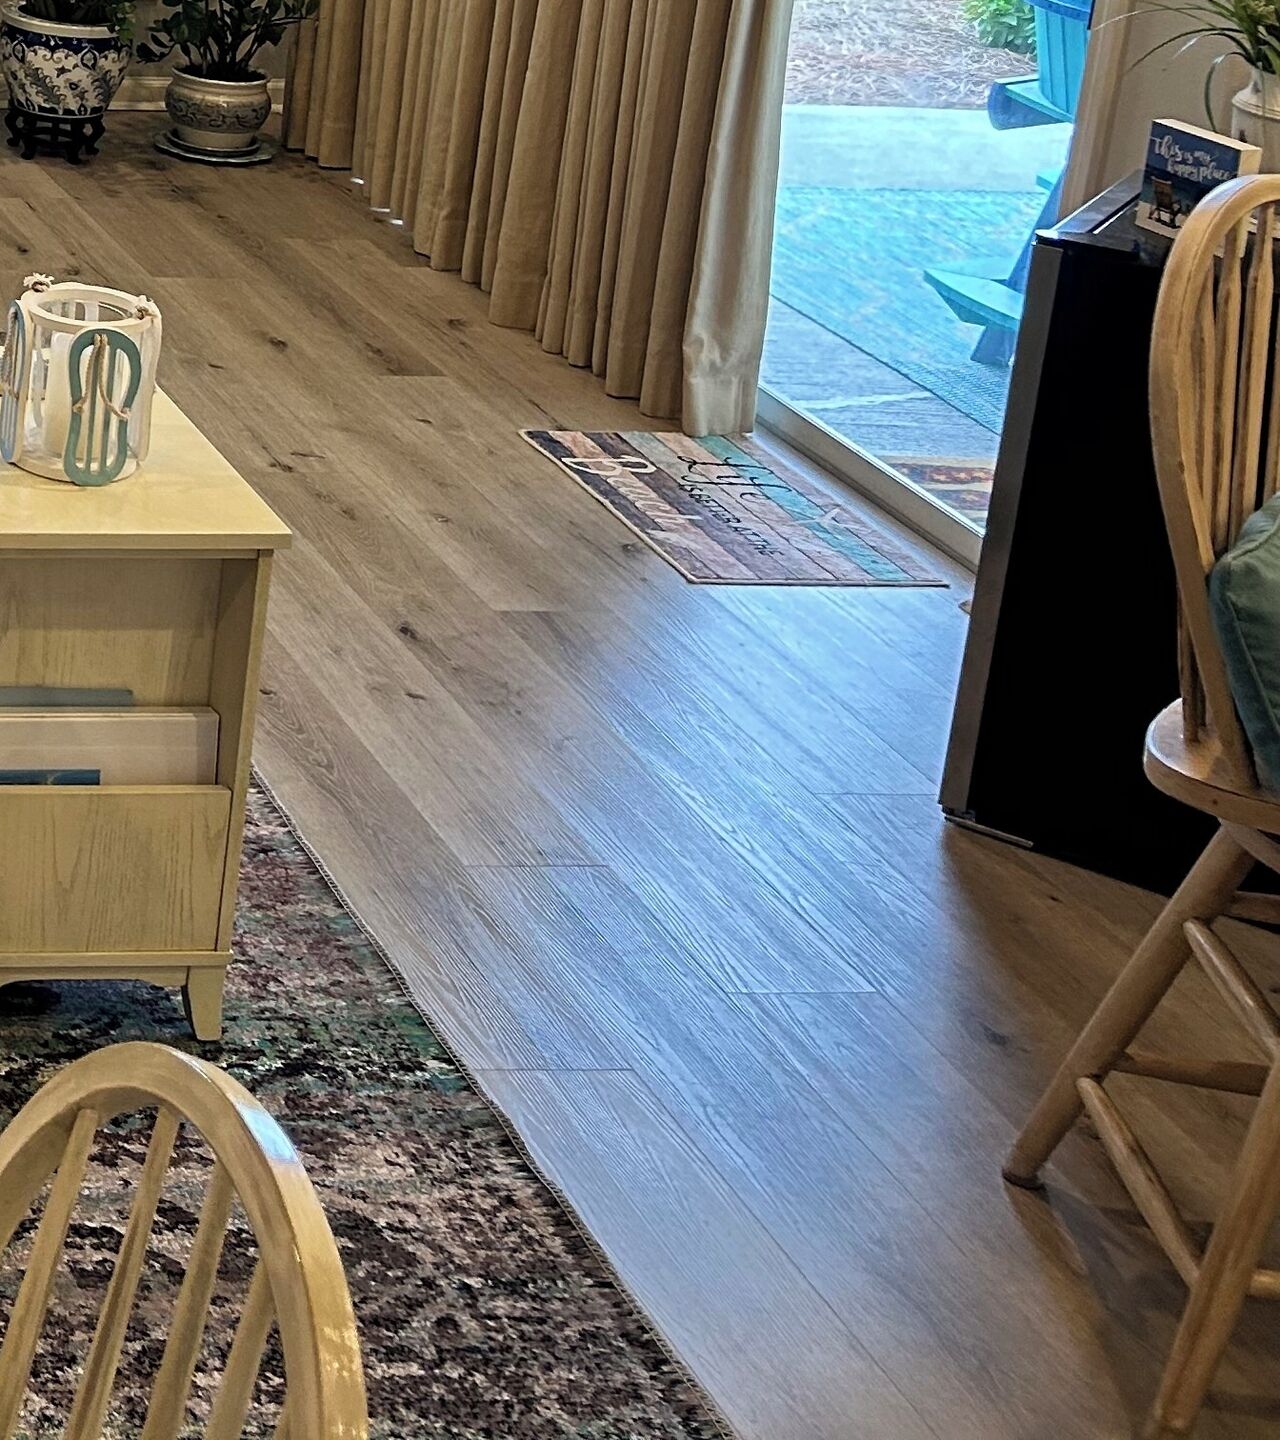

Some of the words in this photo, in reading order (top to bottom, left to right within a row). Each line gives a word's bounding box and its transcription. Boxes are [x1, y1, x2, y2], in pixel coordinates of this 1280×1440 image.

[1150, 135, 1183, 162] This
[1183, 151, 1194, 164] is
[1167, 158, 1200, 182] happy
[1200, 161, 1232, 182] place
[561, 454, 702, 528] Beach
[677, 456, 792, 505] Life
[689, 493, 741, 523] BETTER
